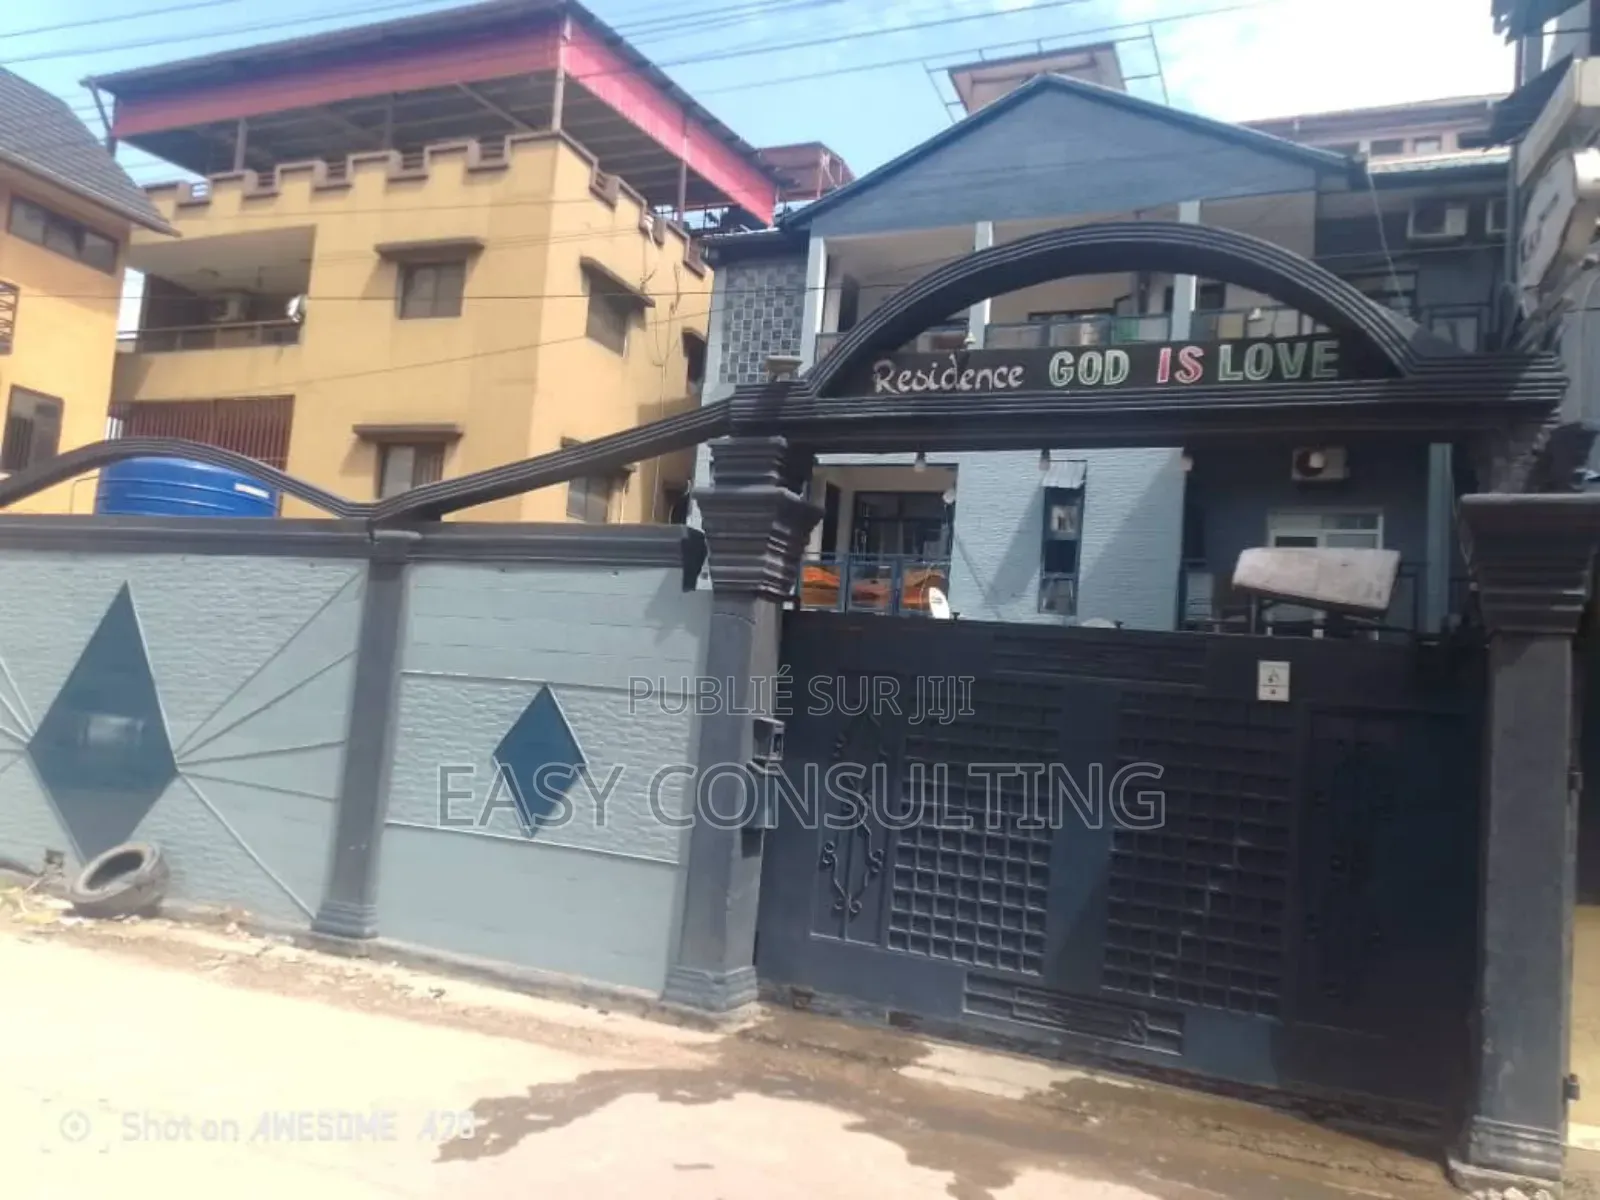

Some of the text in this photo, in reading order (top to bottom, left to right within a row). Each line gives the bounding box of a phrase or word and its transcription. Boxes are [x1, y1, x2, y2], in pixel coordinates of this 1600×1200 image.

[873, 341, 1339, 394] Residence GOD IS LOVE
